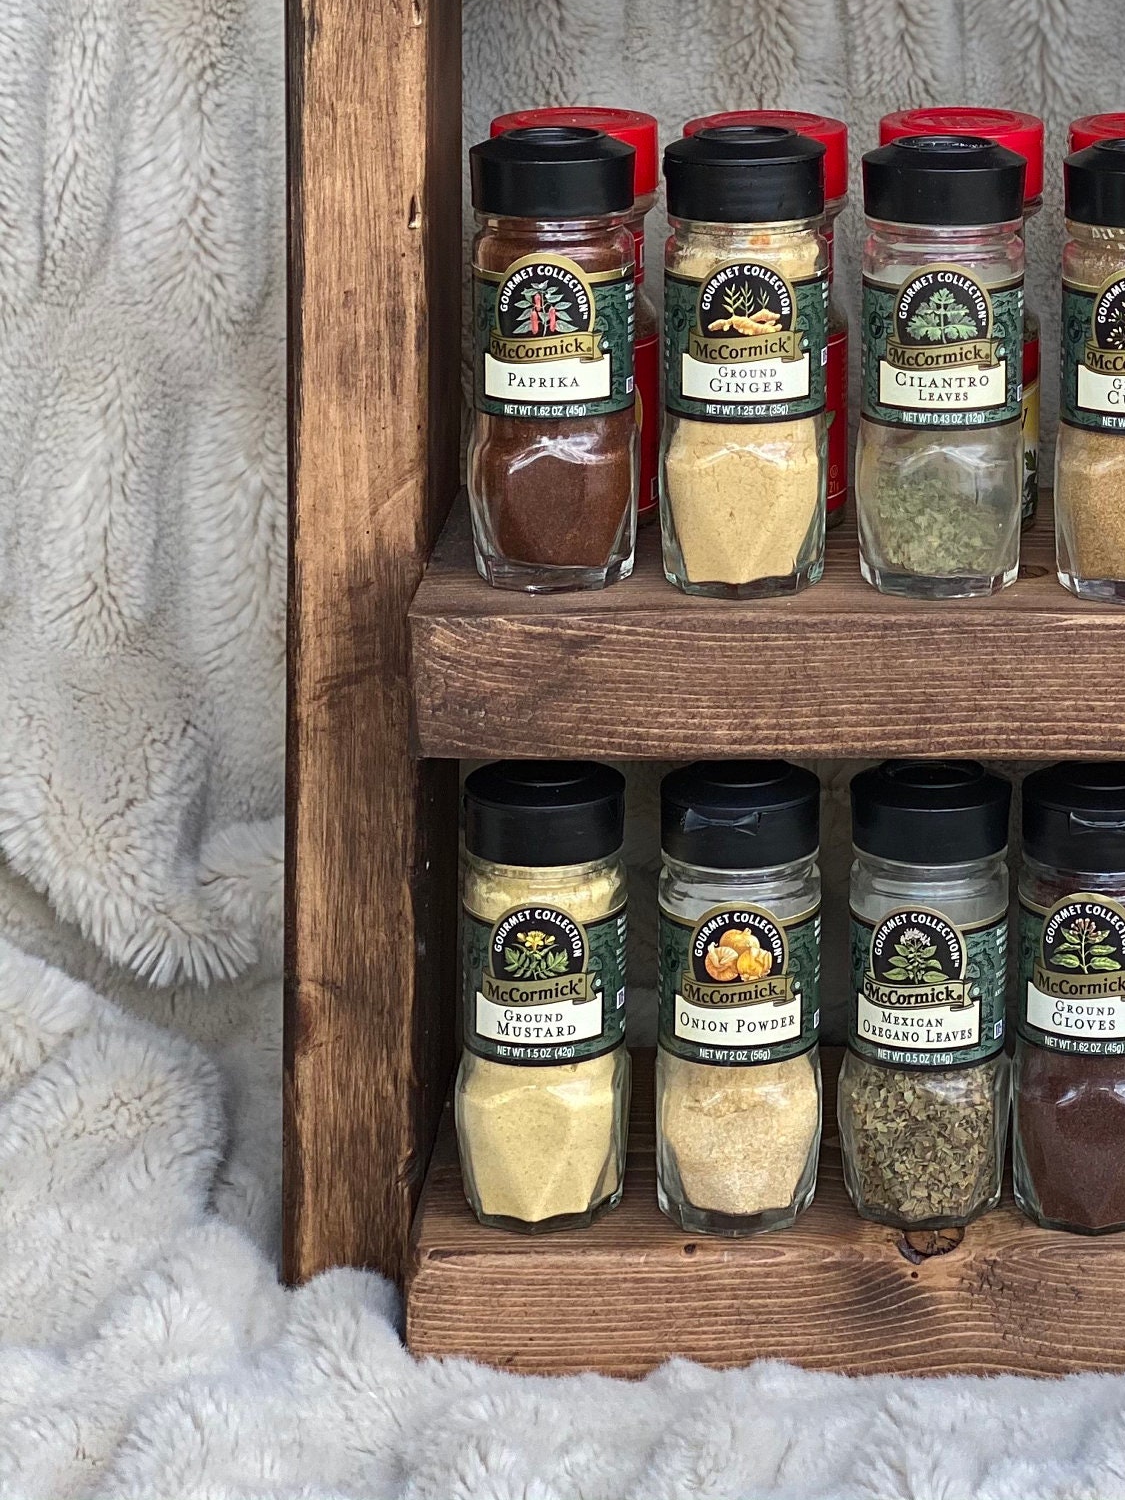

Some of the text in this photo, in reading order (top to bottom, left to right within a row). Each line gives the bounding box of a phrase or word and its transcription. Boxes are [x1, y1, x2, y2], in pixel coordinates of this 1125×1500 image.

[500, 267, 533, 311] GOURMET
[702, 266, 739, 310] GOURMET
[899, 274, 933, 319] GOURMET
[492, 339, 584, 359] McCormick
[694, 338, 789, 359] McCormick
[890, 345, 982, 366] McCormick
[508, 373, 579, 387] PAPRIKA
[719, 367, 777, 378] GROUND
[896, 372, 989, 387] CILANTRO
[710, 378, 783, 393] GINGER
[919, 390, 968, 401] LEAVES
[505, 405, 518, 414] NET
[519, 406, 531, 415] WT
[534, 406, 550, 415] 1.62
[552, 406, 563, 415] OZ
[706, 404, 720, 414] NET
[722, 405, 735, 415] WT
[738, 405, 753, 415] 1.25
[756, 405, 765, 415] OZ
[903, 412, 916, 422] NET
[917, 413, 930, 423] WT
[933, 413, 949, 423] 0.43
[952, 413, 962, 423] OZ
[1103, 417, 1116, 427] NET
[494, 910, 531, 952] GOURMET
[1046, 905, 1081, 944] GOURMET
[695, 914, 729, 957] GOURMET
[875, 914, 907, 955] GOURMET
[486, 980, 580, 1002] McCormick
[684, 982, 777, 1004] McCormick
[865, 982, 955, 1004] McCormick
[504, 1010, 562, 1021] GROUND
[1056, 1000, 1115, 1016] GROUND
[681, 1012, 795, 1033] ONION POWDER
[881, 1011, 943, 1027] MEXICAN
[1052, 1012, 1115, 1030] CLOVES
[497, 1021, 576, 1037] MUSTARD
[863, 1020, 972, 1042] OREGANO LEAVES
[497, 1046, 511, 1055] NET
[512, 1047, 525, 1057] WT
[527, 1048, 539, 1057] 1.5
[540, 1048, 551, 1058] OZ
[1045, 1036, 1058, 1048] NET
[1060, 1039, 1071, 1049] WT
[1073, 1041, 1088, 1052] 1.62
[1091, 1043, 1101, 1052] OZ
[700, 1049, 714, 1058] NET
[715, 1050, 728, 1059] WT
[730, 1051, 734, 1060] 2
[736, 1051, 747, 1060] OZ
[878, 1049, 891, 1059] NET
[892, 1051, 905, 1062] WT
[906, 1052, 918, 1063] 0.5
[919, 1053, 930, 1064] OZ
